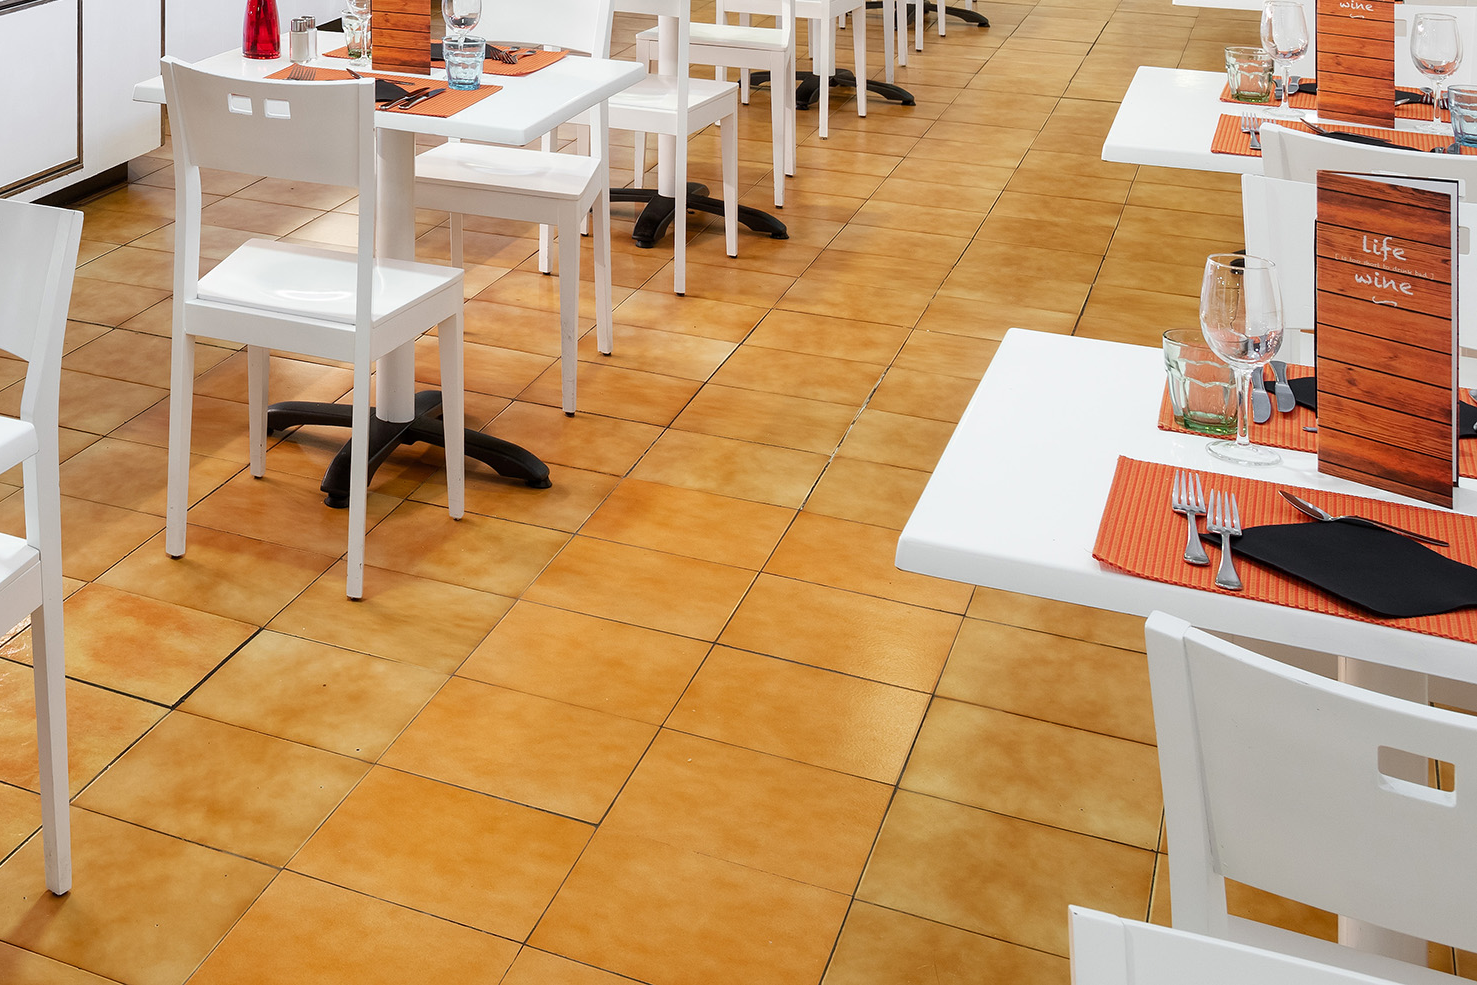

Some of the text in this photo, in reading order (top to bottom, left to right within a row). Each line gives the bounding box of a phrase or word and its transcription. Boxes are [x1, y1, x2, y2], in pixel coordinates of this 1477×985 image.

[1339, 0, 1374, 12] wine
[1362, 235, 1407, 262] life
[1354, 271, 1414, 296] wine
